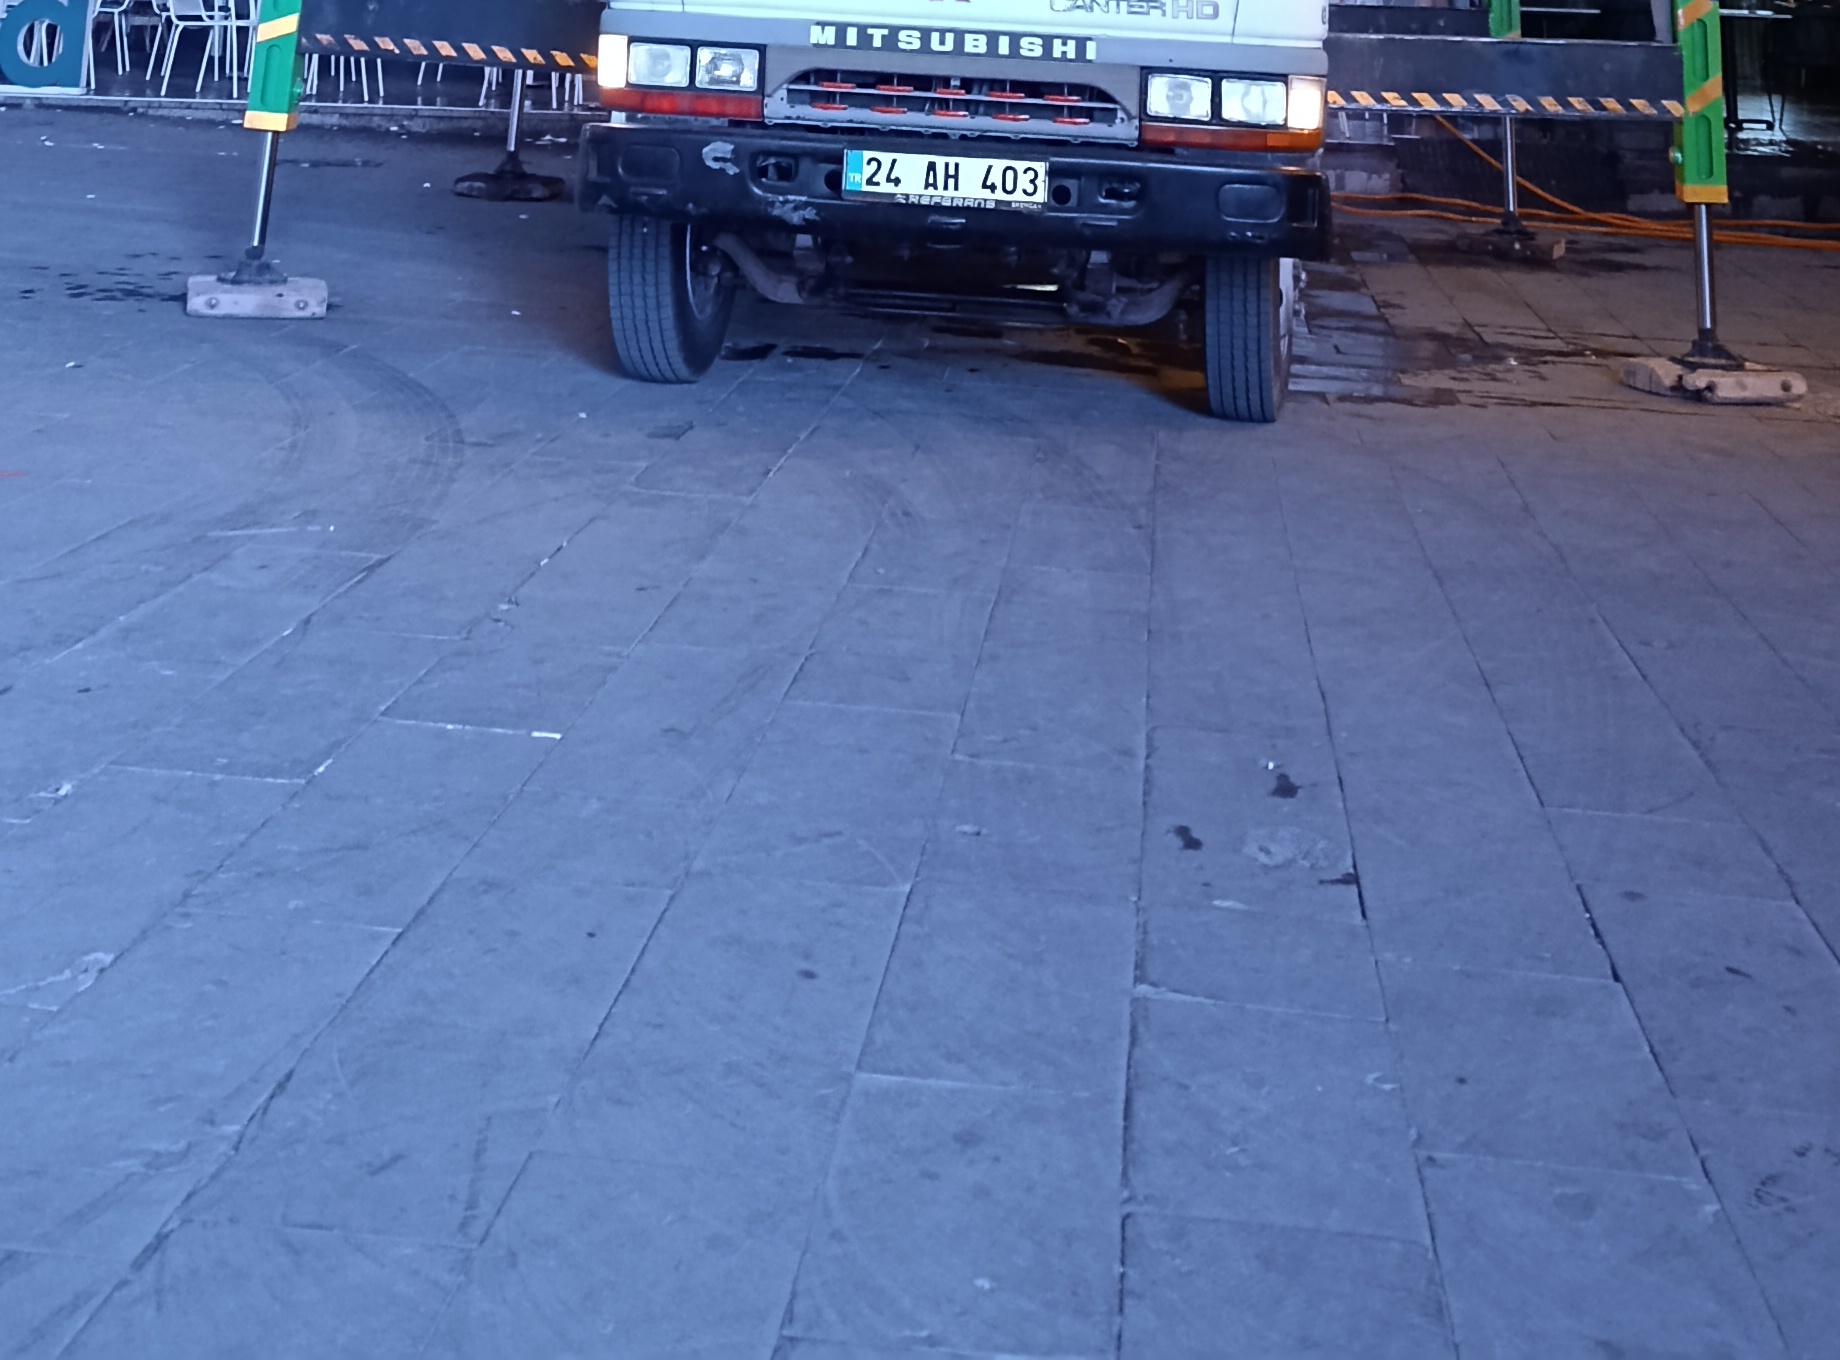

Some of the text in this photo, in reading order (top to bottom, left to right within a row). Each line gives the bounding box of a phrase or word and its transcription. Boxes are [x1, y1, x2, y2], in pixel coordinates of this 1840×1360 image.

[1172, 0, 1220, 20] HD
[809, 25, 1097, 61] MITSUBISHI
[848, 157, 1039, 197] TR 24 AH 403
